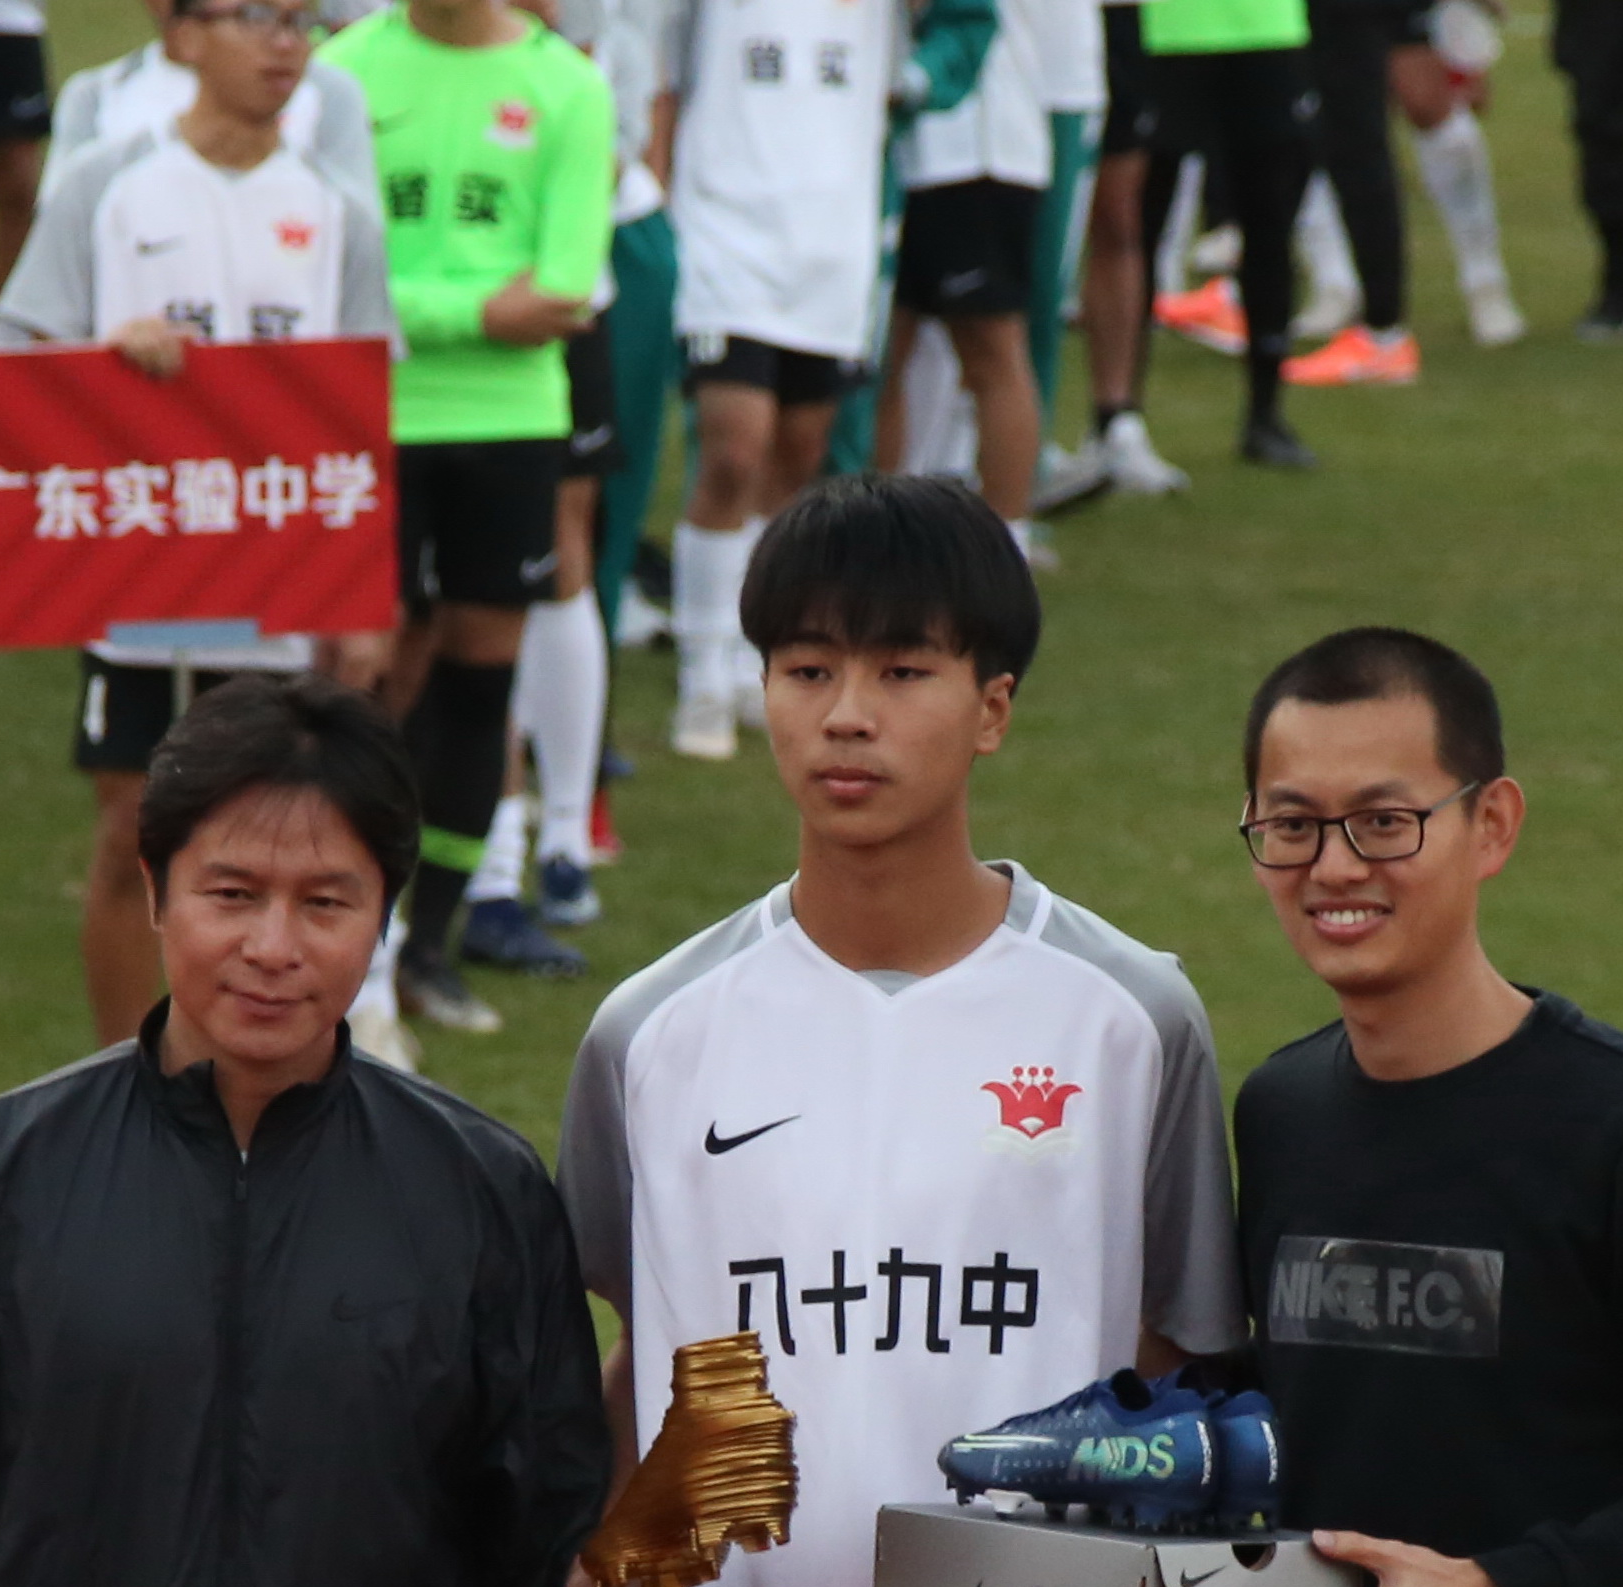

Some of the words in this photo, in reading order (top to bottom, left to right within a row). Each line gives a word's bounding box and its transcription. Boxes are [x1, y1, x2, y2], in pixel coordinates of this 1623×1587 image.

[729, 1247, 1039, 1355] 八十九中
[1273, 1260, 1379, 1324] NIKE
[1387, 1267, 1476, 1332] F.C.
